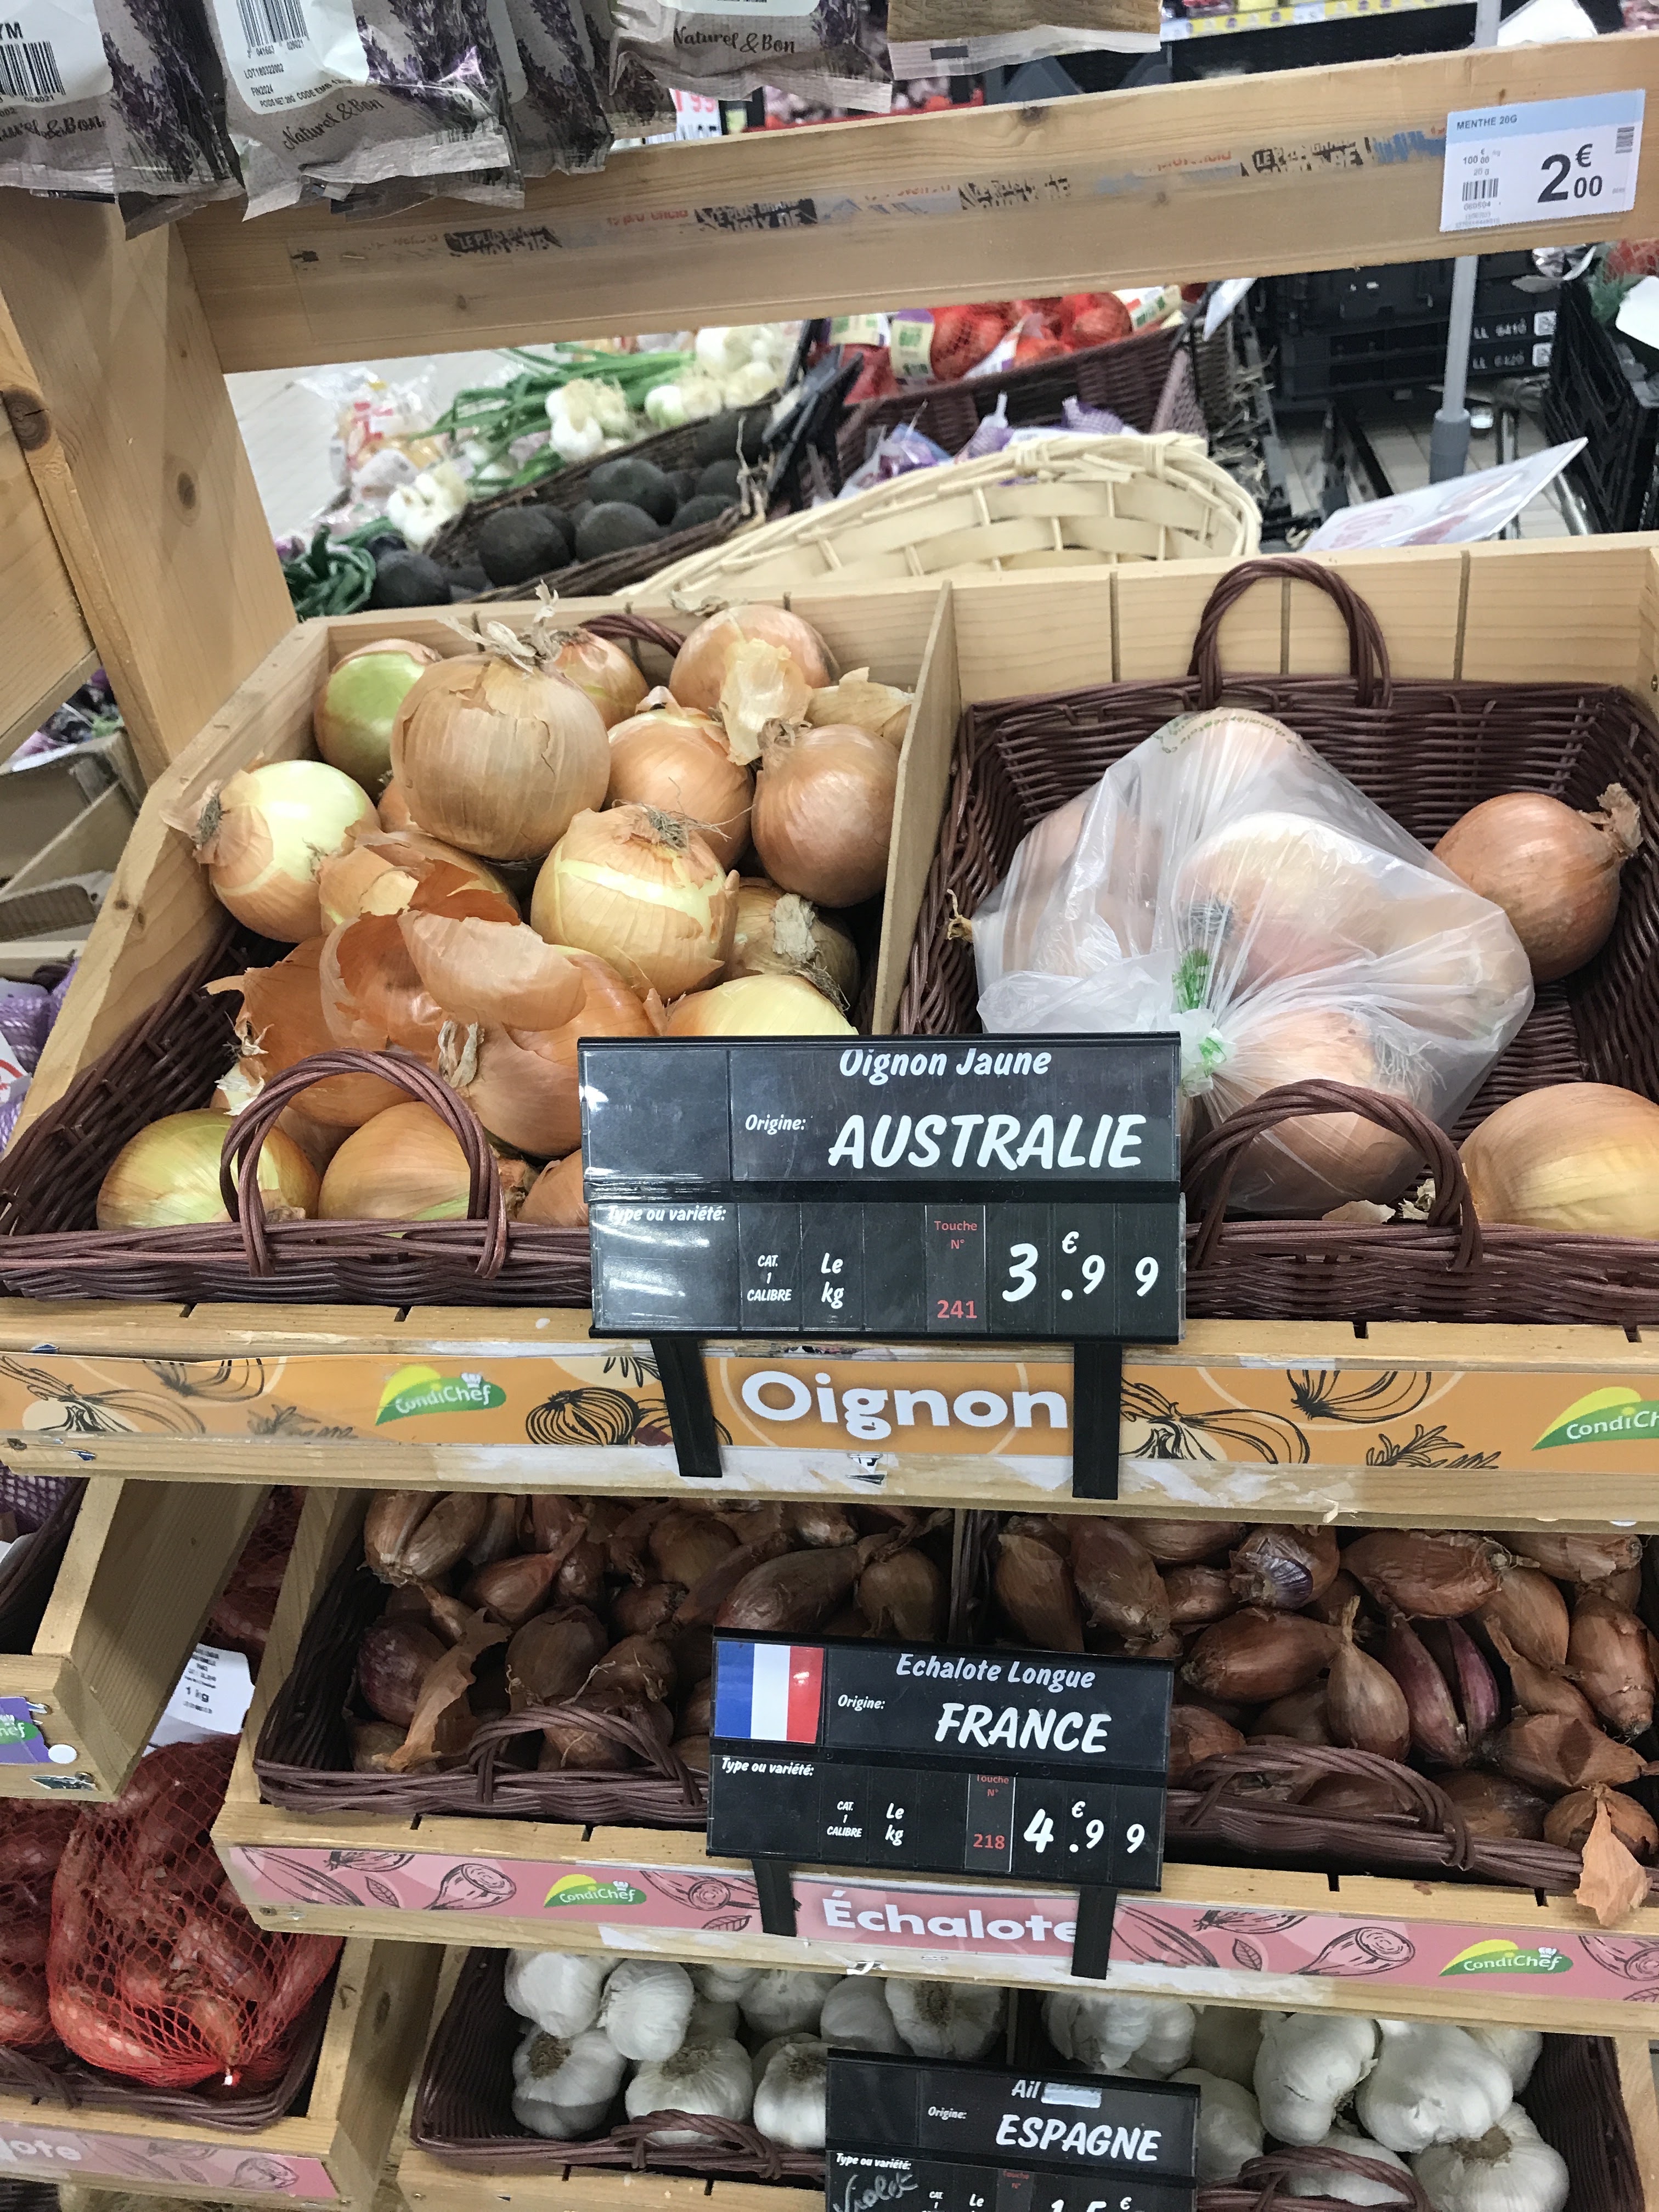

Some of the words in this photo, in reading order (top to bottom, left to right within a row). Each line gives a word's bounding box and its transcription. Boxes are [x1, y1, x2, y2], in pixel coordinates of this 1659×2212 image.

[674, 26, 738, 49] Naturel
[740, 32, 759, 53] &
[762, 33, 795, 54] Bon
[296, 89, 317, 100] CODE
[281, 111, 341, 150] Naturel
[348, 98, 385, 113] Bon
[1457, 116, 1497, 130] MENTHE
[1499, 114, 1517, 126] 20G
[1463, 155, 1479, 165] 100
[1480, 156, 1490, 164] 00
[1575, 143, 1593, 168] €
[1538, 154, 1572, 204] 2
[1574, 175, 1603, 199] 00
[839, 1049, 947, 1086] Oignon
[956, 1048, 1052, 1076] Jaune
[745, 1114, 806, 1135] Origine:
[828, 1114, 1146, 1171] AUSTRALIE
[607, 1205, 642, 1224] Type
[646, 1209, 665, 1222] ou
[669, 1205, 726, 1222] variété:
[934, 1220, 978, 1232] Touche
[950, 1238, 966, 1250] N°
[1062, 1231, 1080, 1254] €
[757, 1254, 778, 1268] CAT.
[820, 1252, 844, 1274] Le
[766, 1272, 772, 1285] 1
[1002, 1242, 1039, 1302] 3
[1135, 1256, 1159, 1297] 9
[747, 1288, 792, 1302] CALIBRE
[821, 1281, 845, 1310] kg
[936, 1299, 978, 1319] 241
[395, 1383, 492, 1414] CondiChef
[742, 1370, 1068, 1440] Oignon
[896, 1653, 1002, 1681] Echalote
[1007, 1661, 1096, 1694] Longue
[838, 1694, 886, 1712] Origine:
[934, 1702, 1112, 1753] FRANCE
[721, 1757, 749, 1774] Type
[752, 1762, 765, 1773] ou
[769, 1763, 815, 1776] variété:
[975, 1774, 1010, 1785] Touche
[986, 1788, 1000, 1797] N°
[837, 1801, 854, 1812] CAT.
[885, 1803, 905, 1820] Le
[1071, 1801, 1086, 1818] €
[842, 1814, 848, 1824] 1
[826, 1826, 863, 1838] CALIBRE
[884, 1824, 904, 1847] kg
[1024, 1808, 1054, 1853] 4
[1126, 1824, 1146, 1854] 9
[973, 1833, 1006, 1850] 218
[559, 1888, 635, 1903] CondiChef
[823, 1891, 1077, 1943] Échalote
[1463, 1955, 1563, 1972] CondiChef
[1011, 2079, 1041, 2100] Ail
[928, 2106, 966, 2121] Origine:
[996, 2113, 1162, 2162] ESPAGNE
[836, 2152, 859, 2166] Type
[860, 2158, 872, 2166] ou
[874, 2158, 912, 2170] variété:
[969, 2193, 984, 2208] Le
[1120, 2197, 1132, 2210] €
